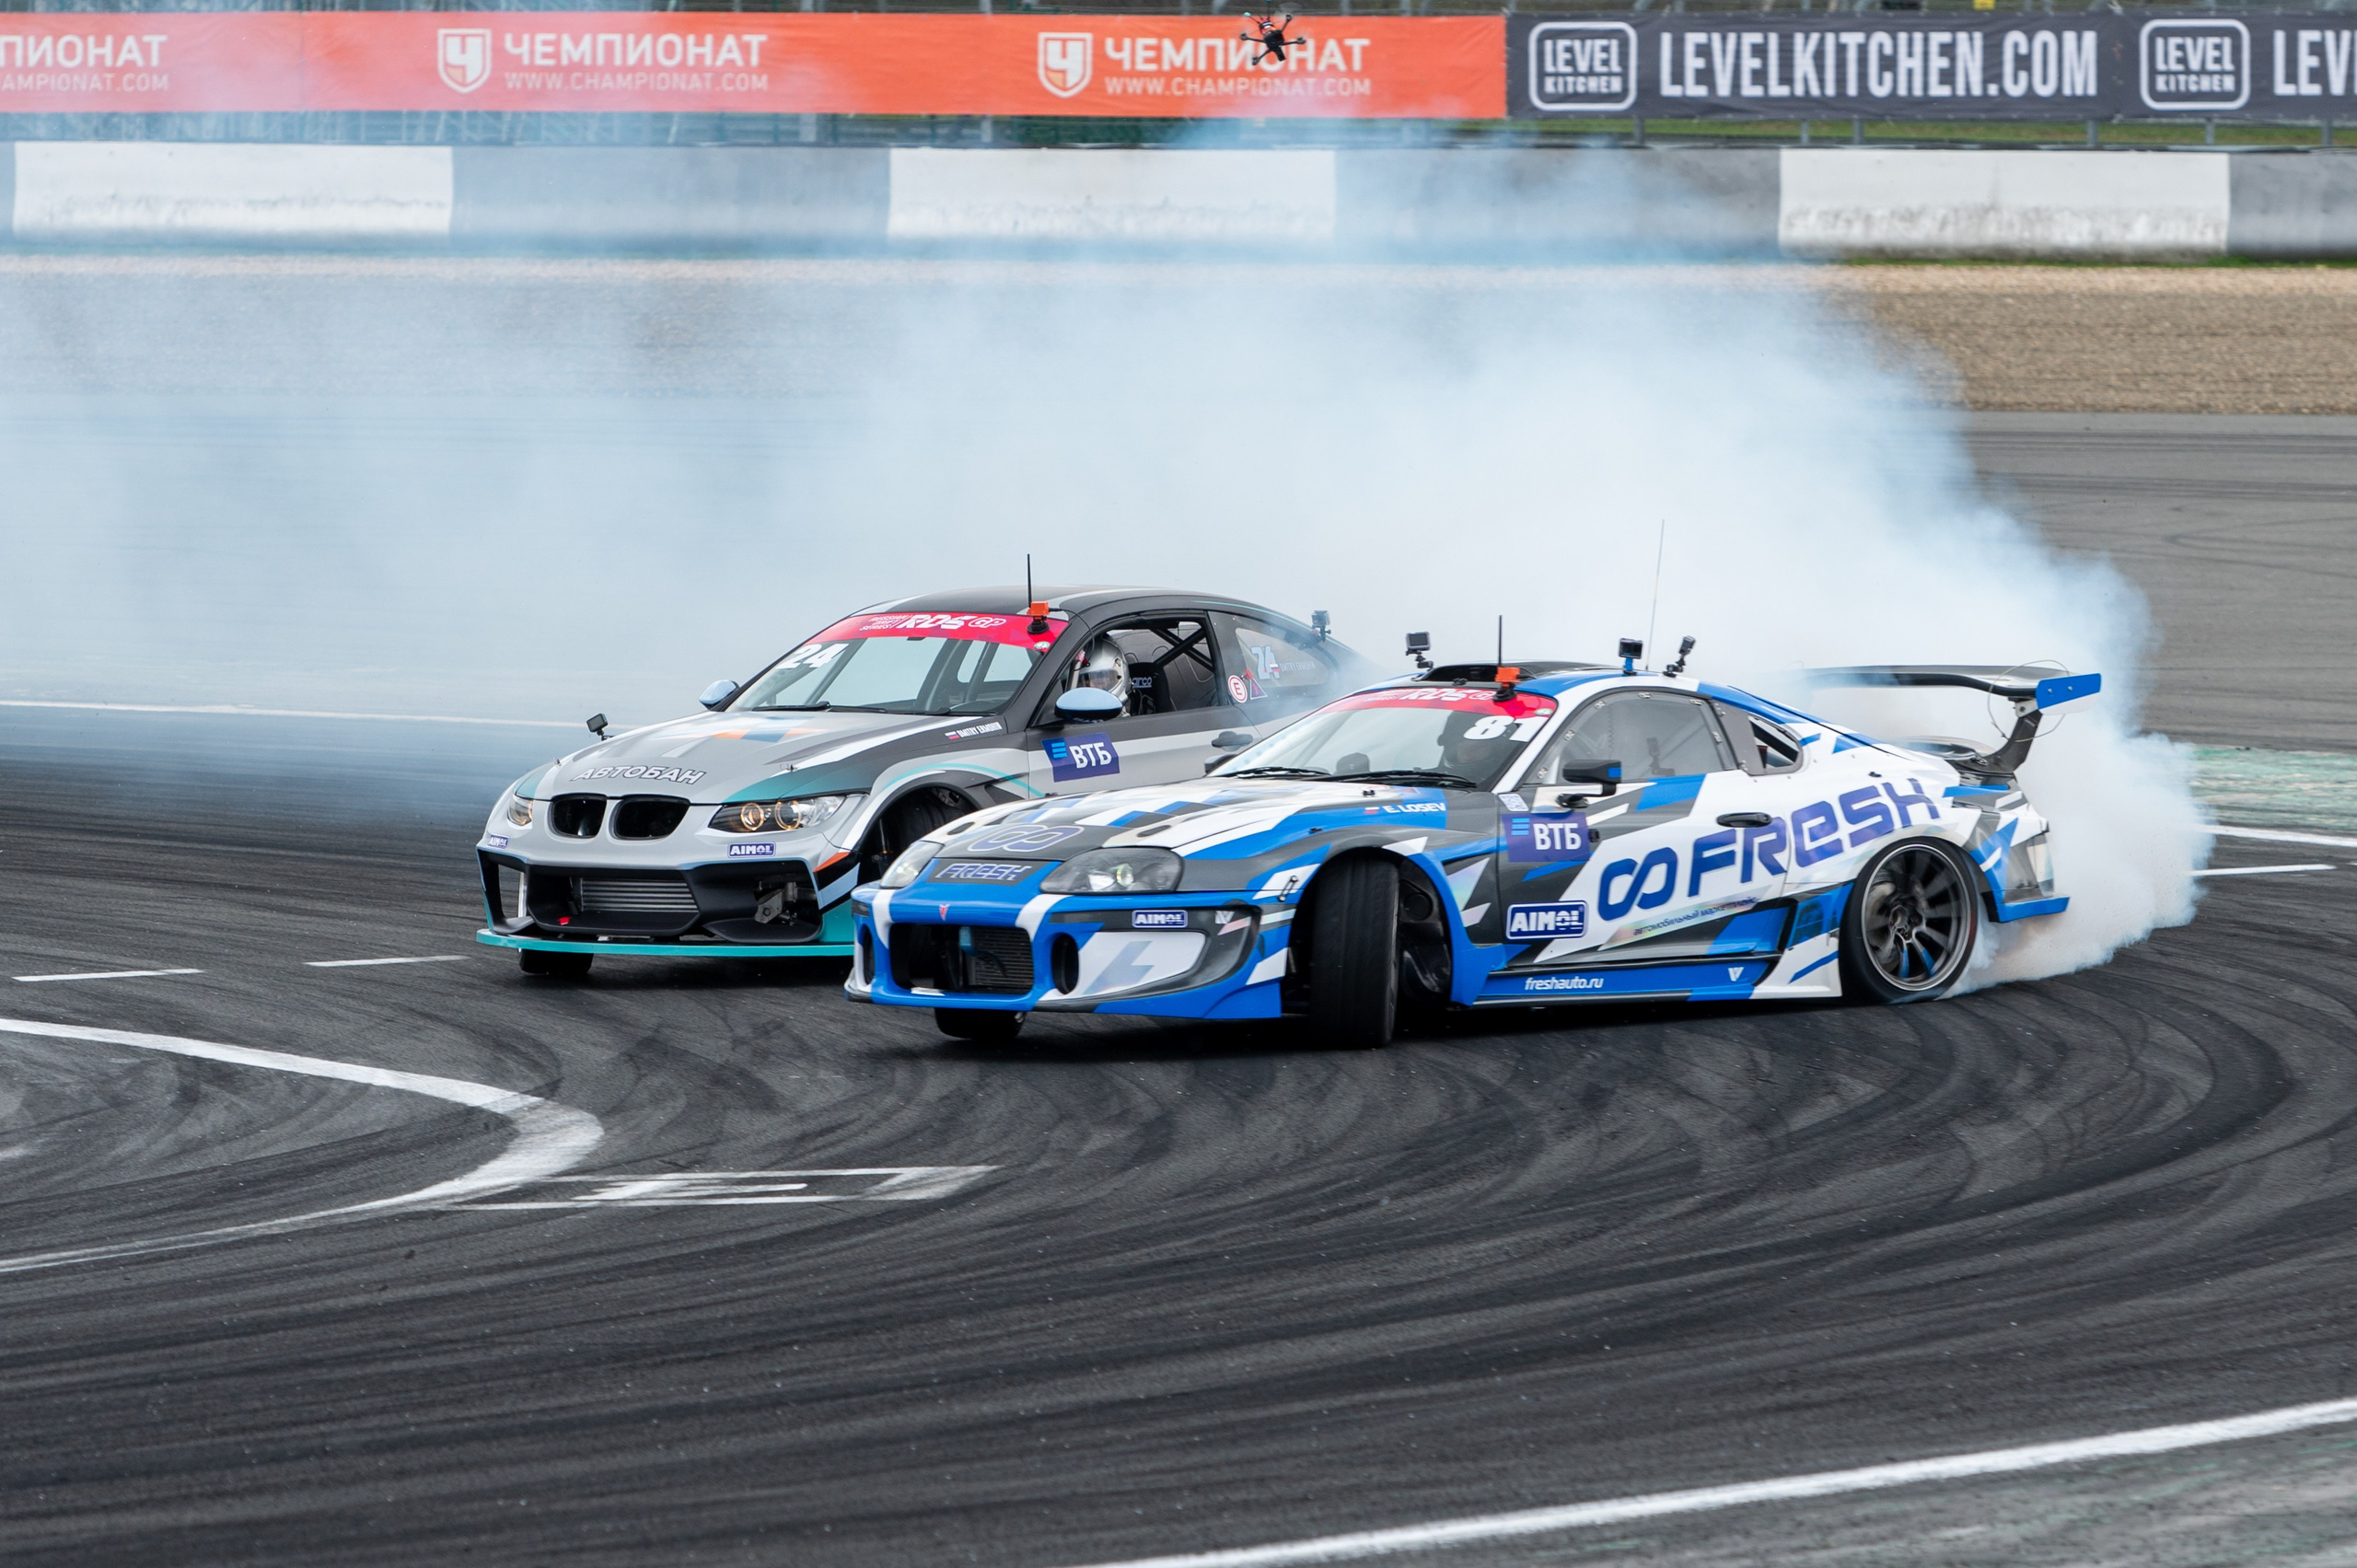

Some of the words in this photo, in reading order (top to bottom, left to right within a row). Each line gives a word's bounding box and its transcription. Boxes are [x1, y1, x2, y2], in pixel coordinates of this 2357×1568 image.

[505, 33, 769, 67] ЧЕМПИОНАТ
[1544, 39, 1622, 73] LEVEL
[2155, 36, 2235, 72] LEVEL
[1660, 30, 2098, 98] LEVELKITCHEN.COM
[2273, 29, 2357, 97] LEV
[505, 71, 769, 92] WWW.CHAMPIONAT.COM
[1106, 76, 1371, 97] WWW.CHAMPIONAT.COM
[1544, 75, 1622, 93] KITCHEN
[2155, 74, 2235, 92] KITCHEN
[775, 644, 849, 669] 24
[1132, 677, 1153, 687] arco
[1464, 715, 1550, 742] 81
[1069, 742, 1112, 769] ВТБ
[570, 765, 706, 784] АВТОБАН
[1397, 802, 1446, 812] LOSEV
[1532, 823, 1582, 851] ВТБ
[730, 844, 773, 855] AIMOL
[1135, 912, 1185, 924] AIMOL
[1511, 910, 1584, 933] AIMOL
[1524, 977, 1605, 991] freshauto.ru
